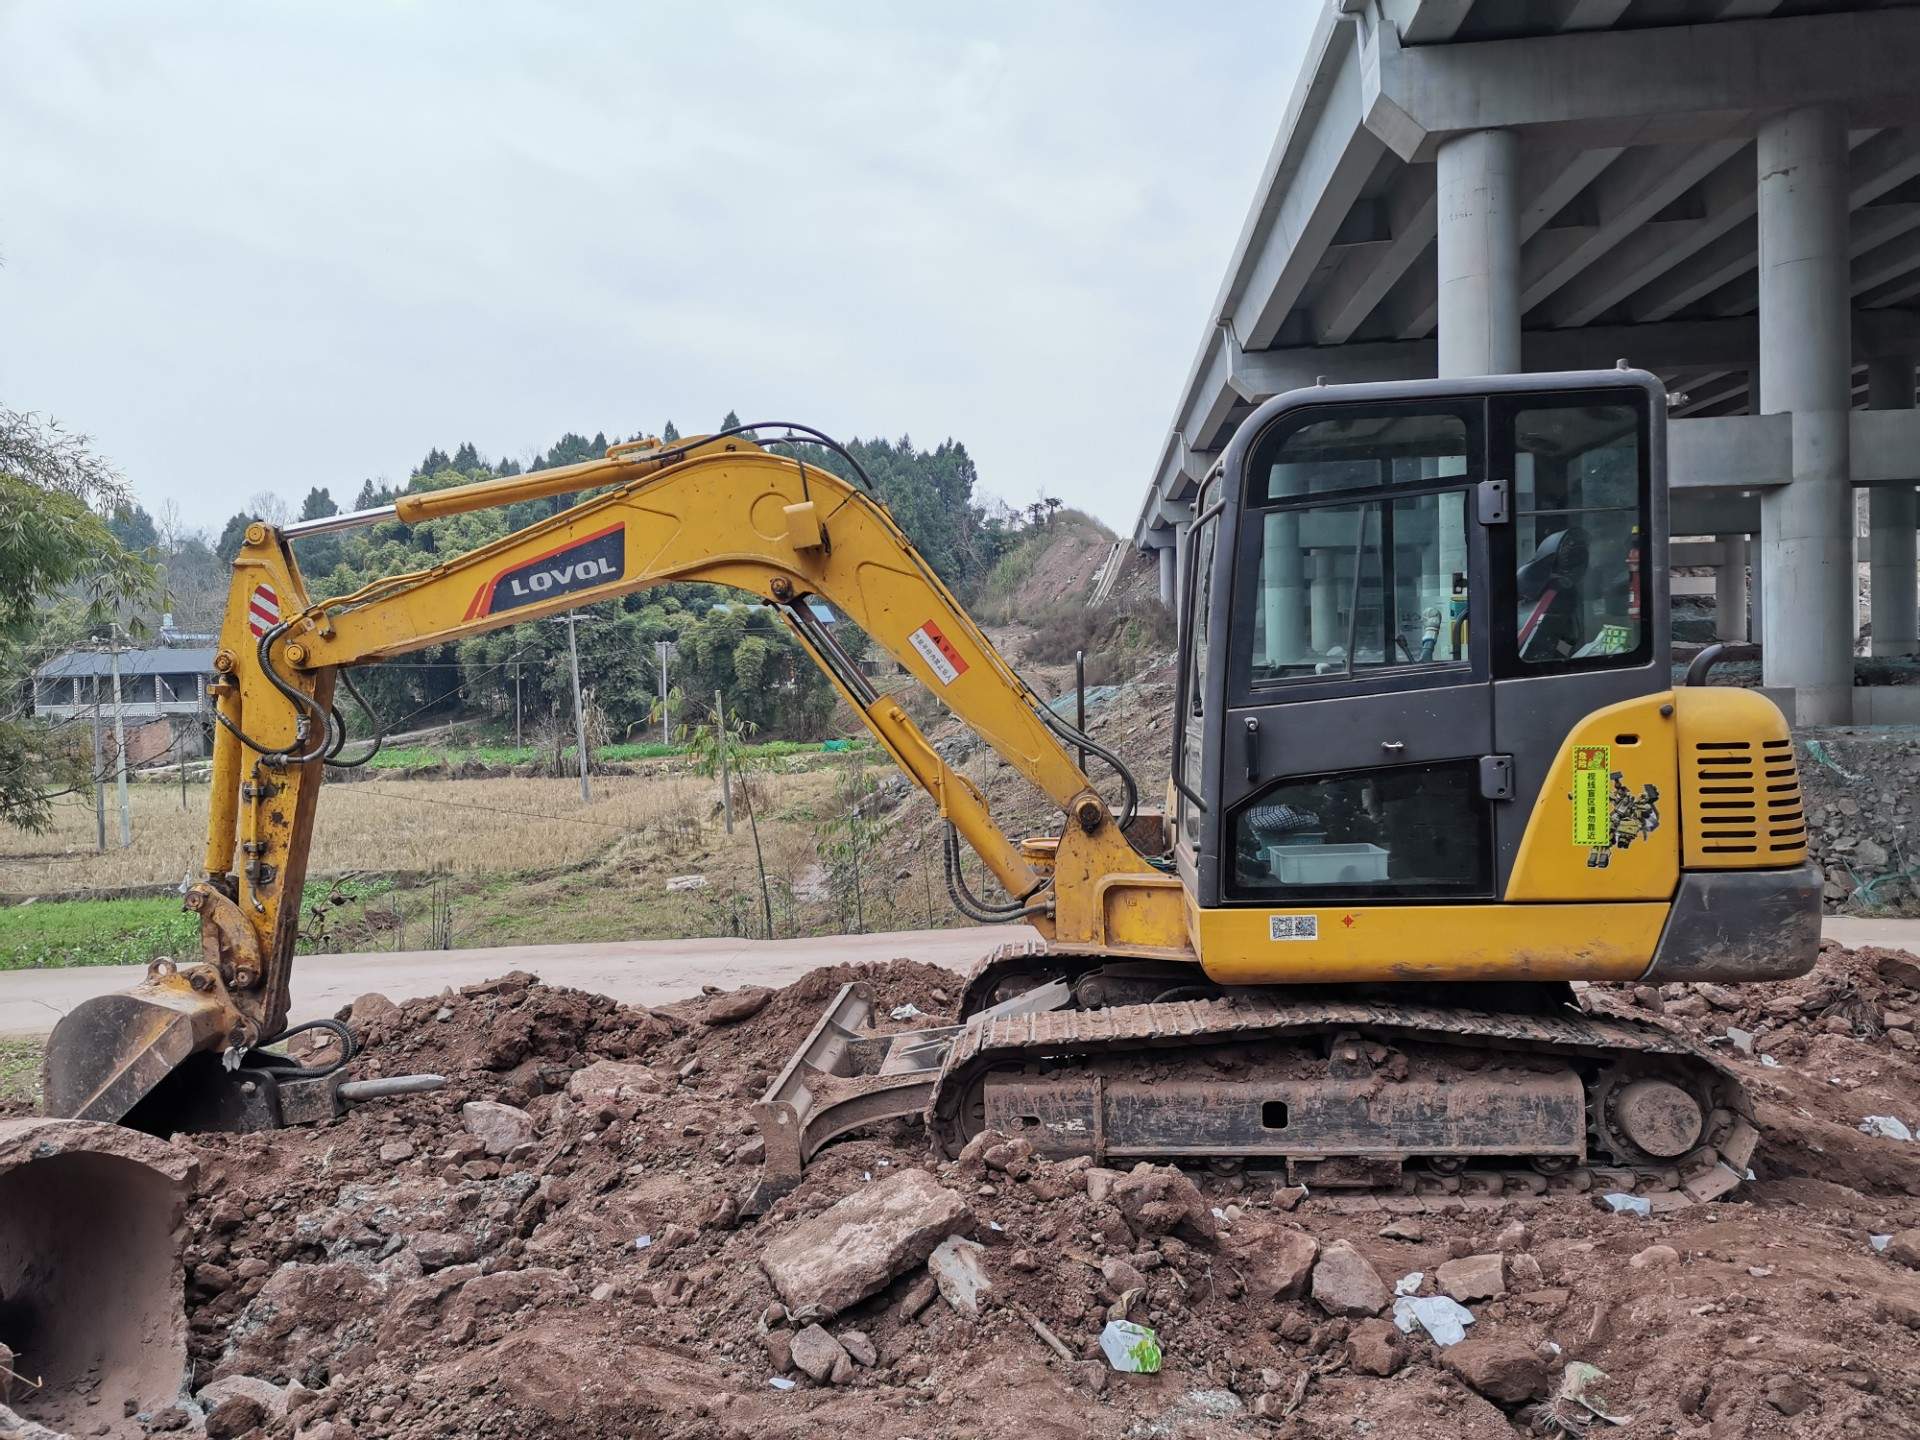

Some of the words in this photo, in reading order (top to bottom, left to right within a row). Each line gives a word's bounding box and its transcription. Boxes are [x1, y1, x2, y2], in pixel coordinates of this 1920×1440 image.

[511, 557, 616, 596] LOVOL
[1587, 772, 1596, 840] 视线盲区请勿靠近
